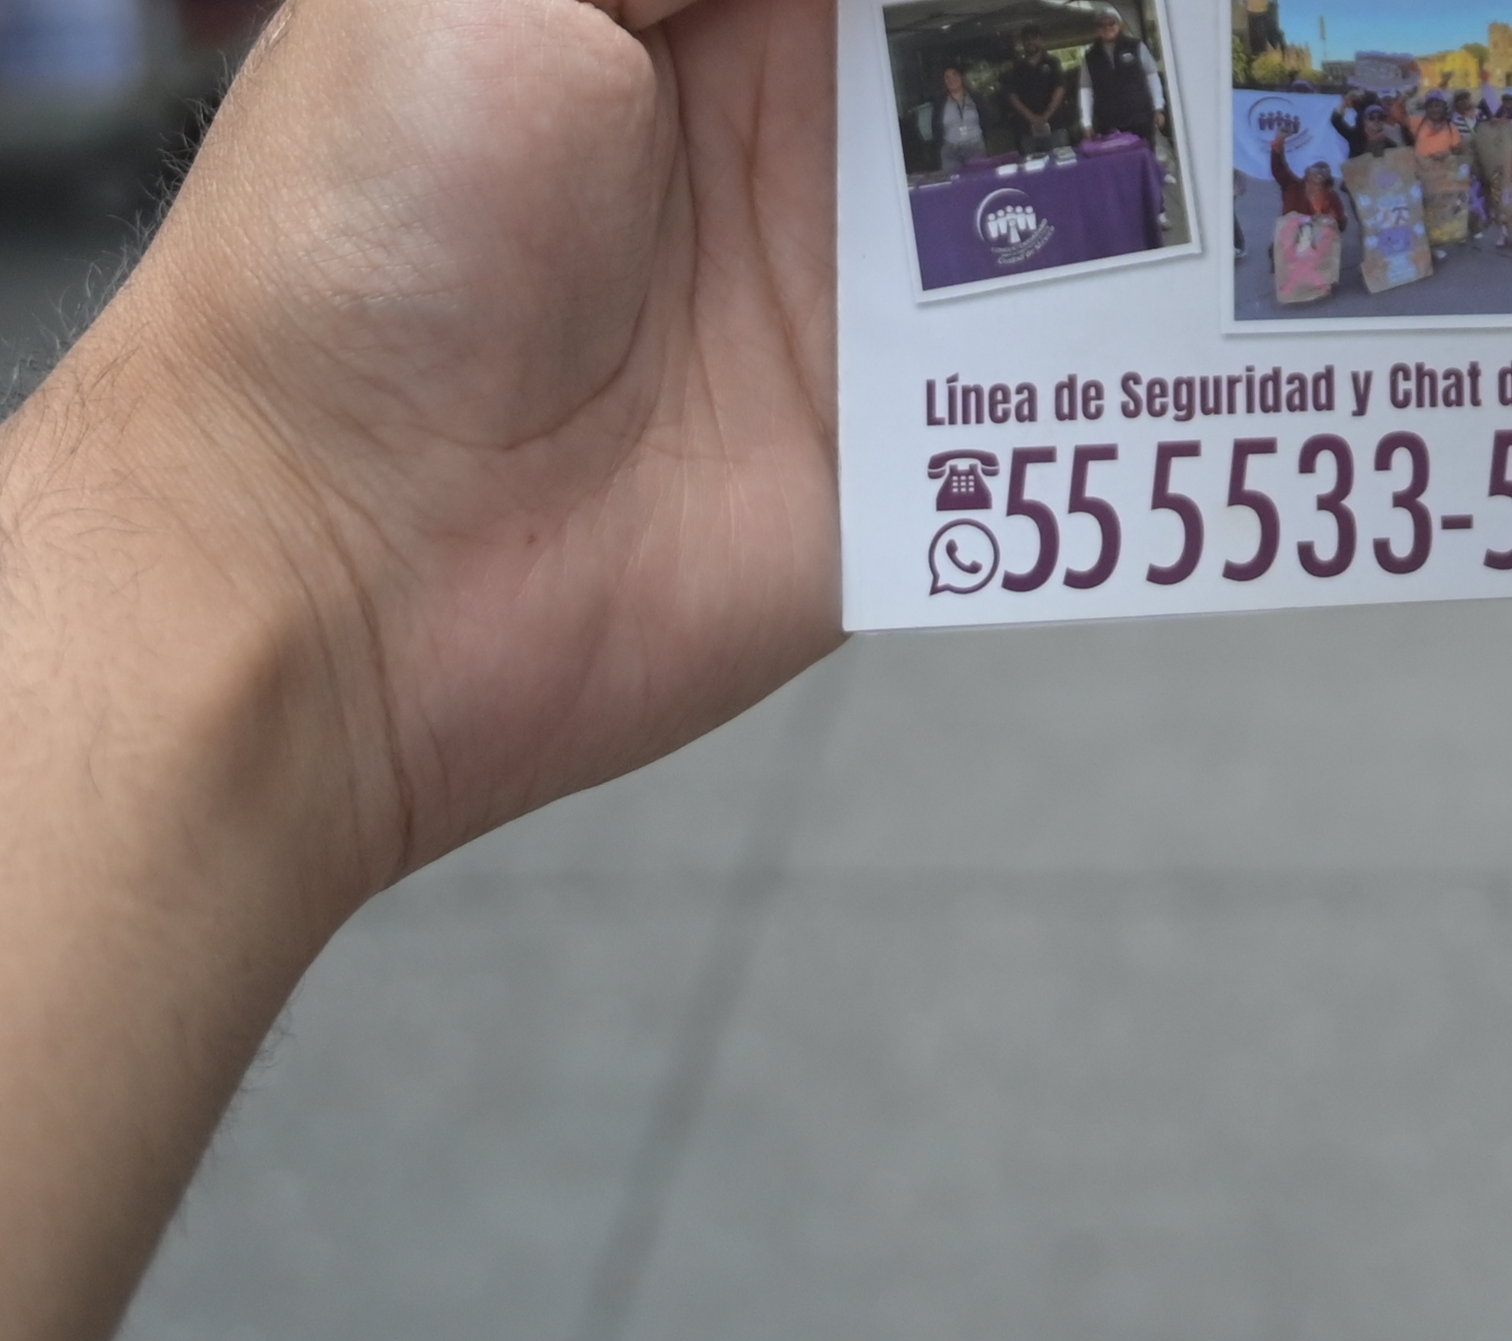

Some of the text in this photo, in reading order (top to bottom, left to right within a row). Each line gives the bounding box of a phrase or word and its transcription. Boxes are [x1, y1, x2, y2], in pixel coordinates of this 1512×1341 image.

[926, 373, 1038, 427] Línea
[1054, 374, 1105, 422] de
[1120, 364, 1335, 423] Seguridad
[1351, 371, 1373, 417] y
[1389, 361, 1482, 410] Chat
